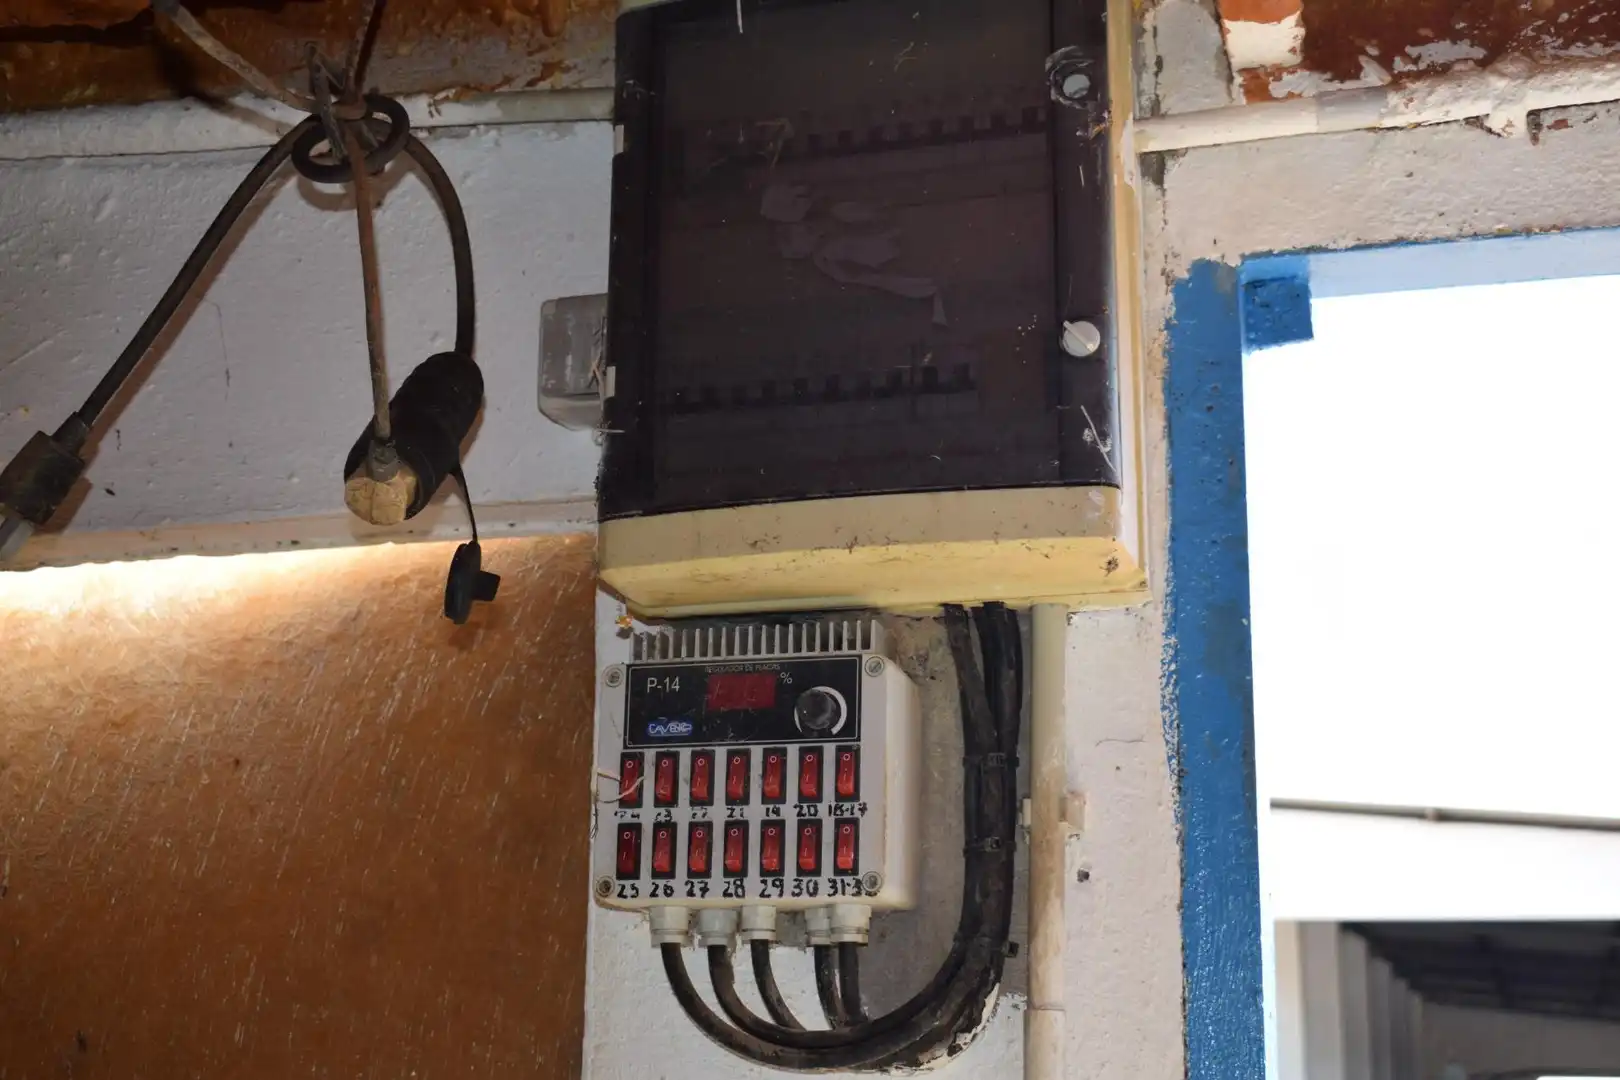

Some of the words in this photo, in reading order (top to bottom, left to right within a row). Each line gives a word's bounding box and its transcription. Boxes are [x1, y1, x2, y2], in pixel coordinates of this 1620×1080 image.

[646, 676, 680, 694] P-14
[780, 672, 793, 684] %
[794, 804, 820, 818] 20
[617, 883, 639, 899] 25
[684, 880, 710, 899] 27
[722, 878, 746, 898] 28
[759, 877, 785, 898] 29
[791, 878, 819, 898] 30
